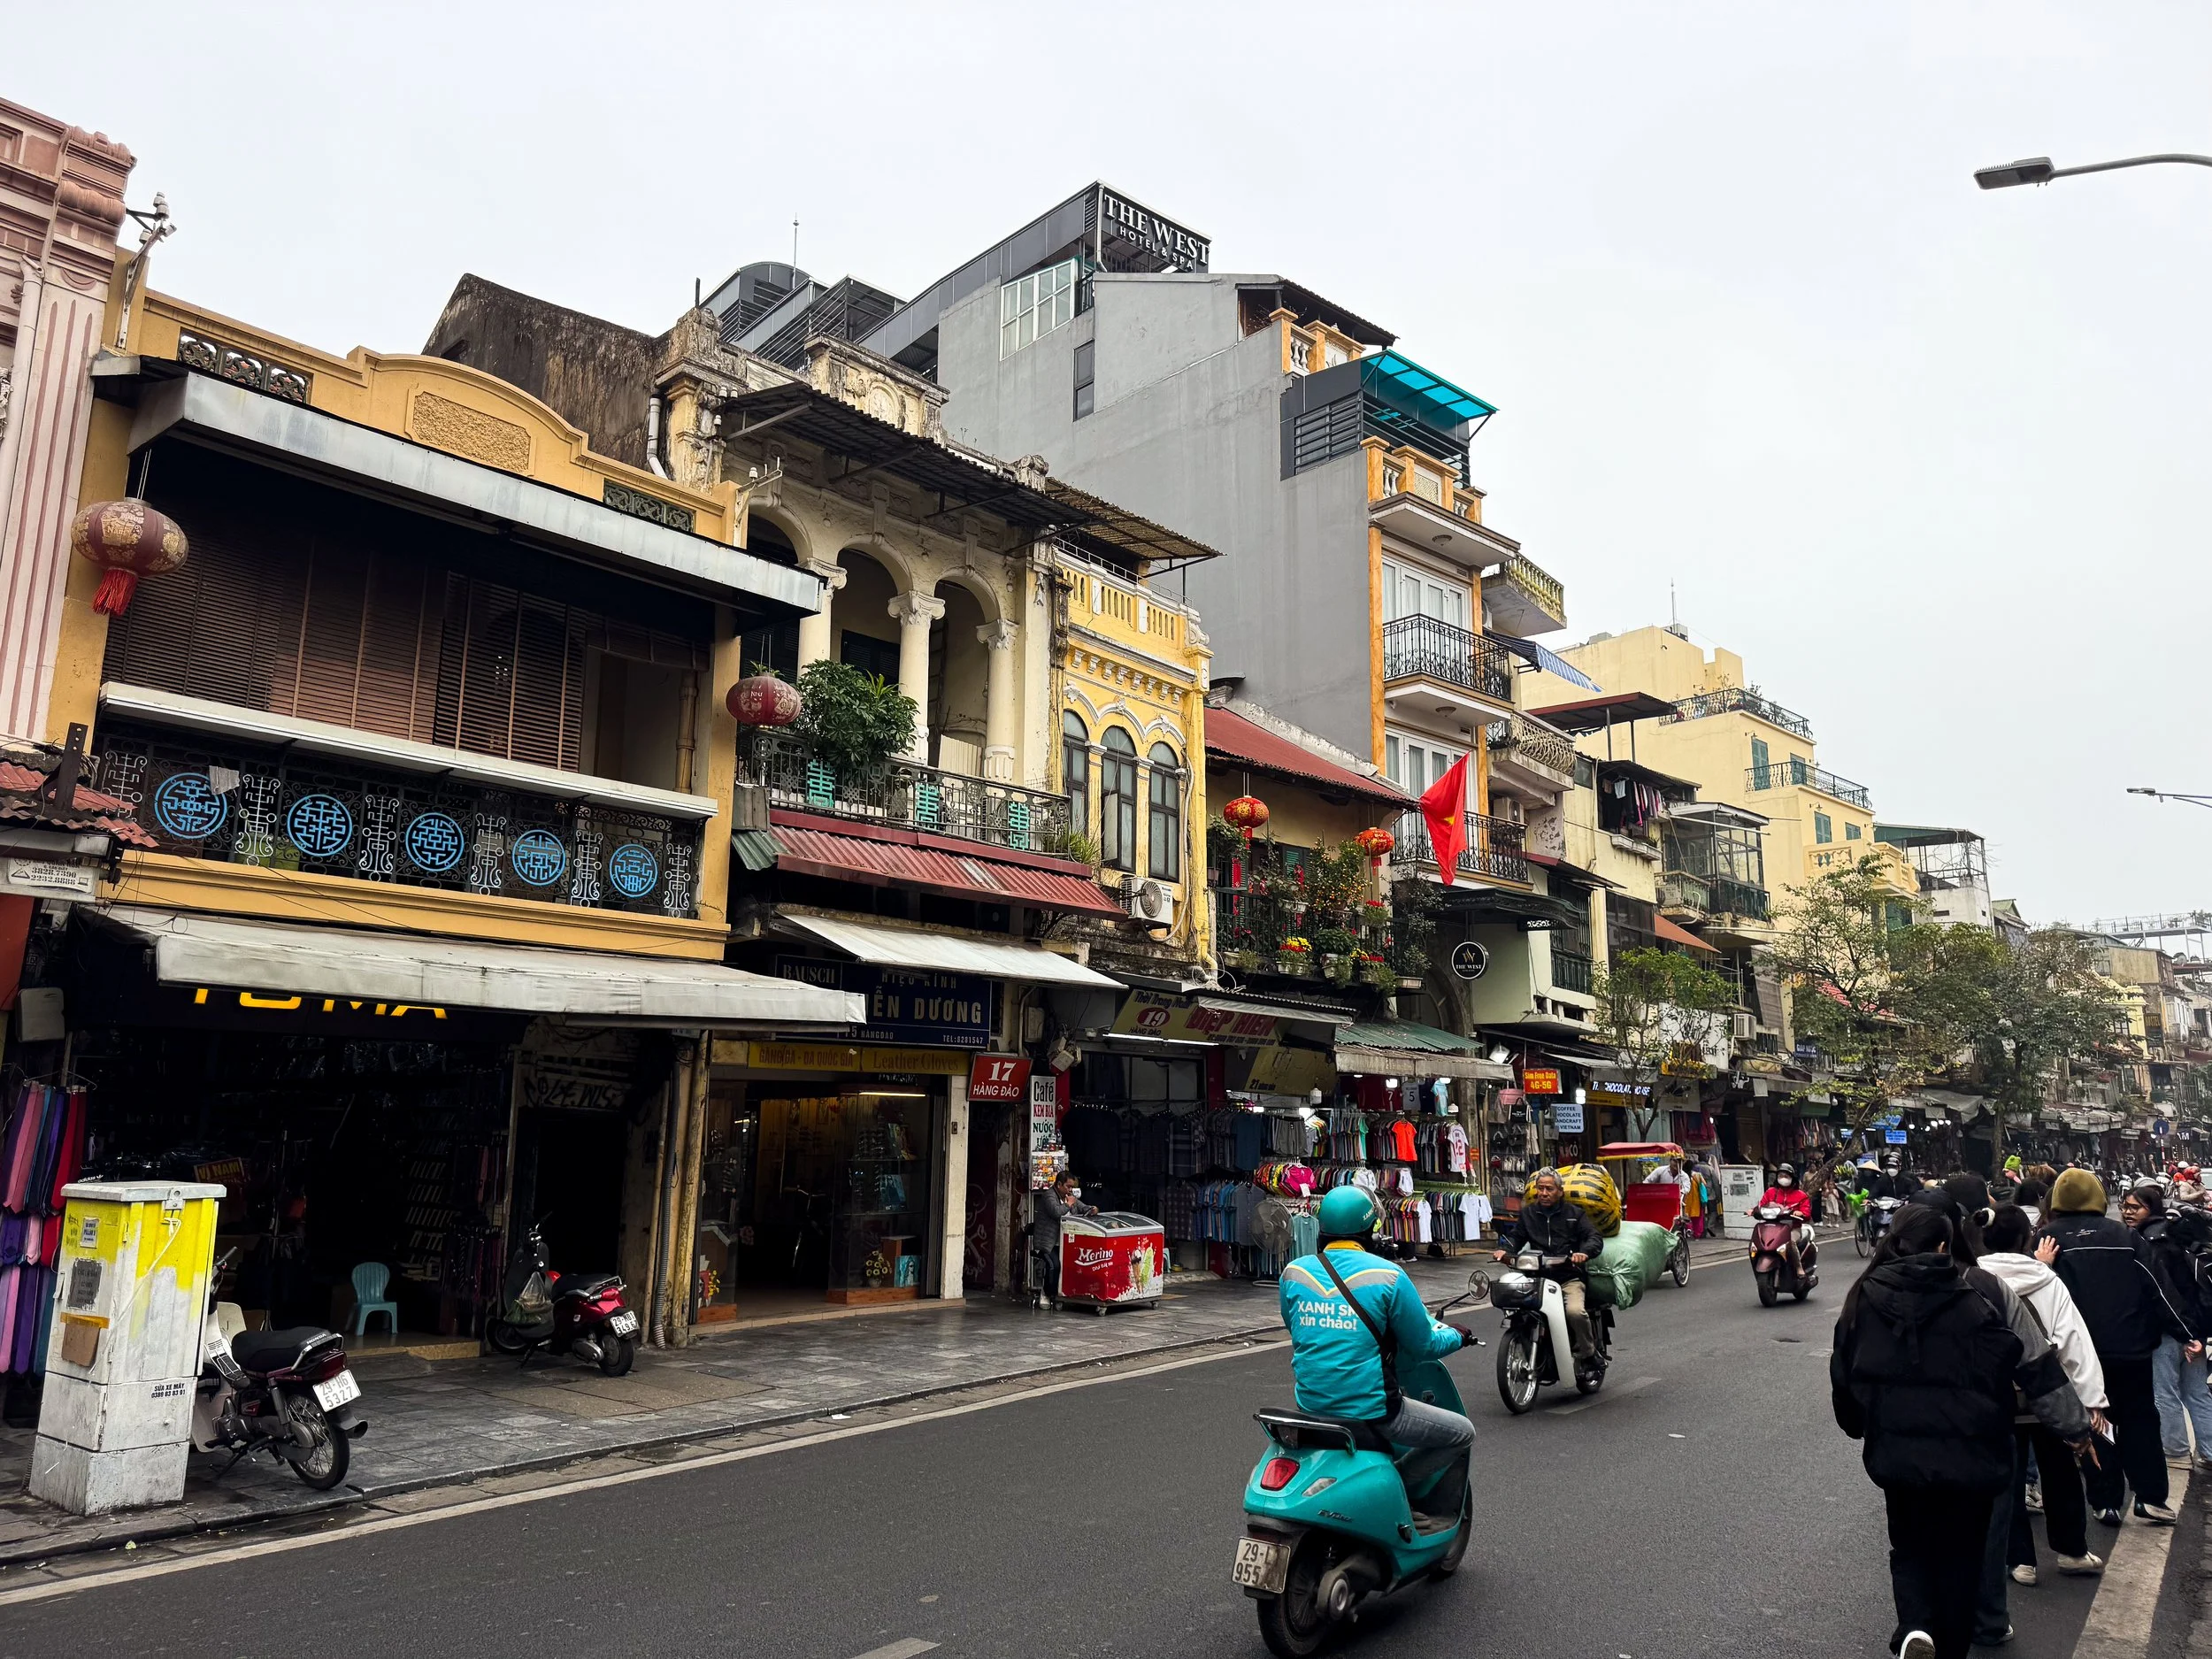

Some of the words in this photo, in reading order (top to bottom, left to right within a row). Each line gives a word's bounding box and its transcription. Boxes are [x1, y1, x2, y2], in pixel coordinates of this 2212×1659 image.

[1104, 194, 1148, 234] THE
[1152, 218, 1210, 265] WEST
[1119, 227, 1156, 252] HOTEL
[1161, 247, 1168, 257] &
[1172, 252, 1194, 270] SPA
[782, 964, 835, 984] BAUSCH
[864, 985, 900, 1018] ỄN
[914, 996, 982, 1024] DƯƠNG
[1141, 1010, 1166, 1026] 19
[873, 1050, 918, 1071] Leather
[921, 1051, 959, 1071] Gloves
[988, 1061, 1017, 1081] 17
[973, 1081, 999, 1096] HÀNG
[1000, 1083, 1019, 1097] ĐÀO
[1033, 1081, 1054, 1102] Café
[1387, 1090, 1394, 1102] 7
[1409, 1091, 1415, 1102] 5
[1033, 1104, 1045, 1118] KEM
[1045, 1104, 1054, 1118] BIA
[1033, 1119, 1054, 1133] NƯỚC
[212, 1161, 241, 1177] NAM
[1078, 1247, 1114, 1262] Merino
[1297, 1301, 1335, 1315] XANH
[1299, 1314, 1316, 1326] xin
[1318, 1315, 1357, 1331] chào!
[306, 1333, 326, 1344] HONDA
[319, 1374, 349, 1396] 29-H6
[325, 1386, 354, 1408] 5327
[1242, 1542, 1275, 1564] 29-L
